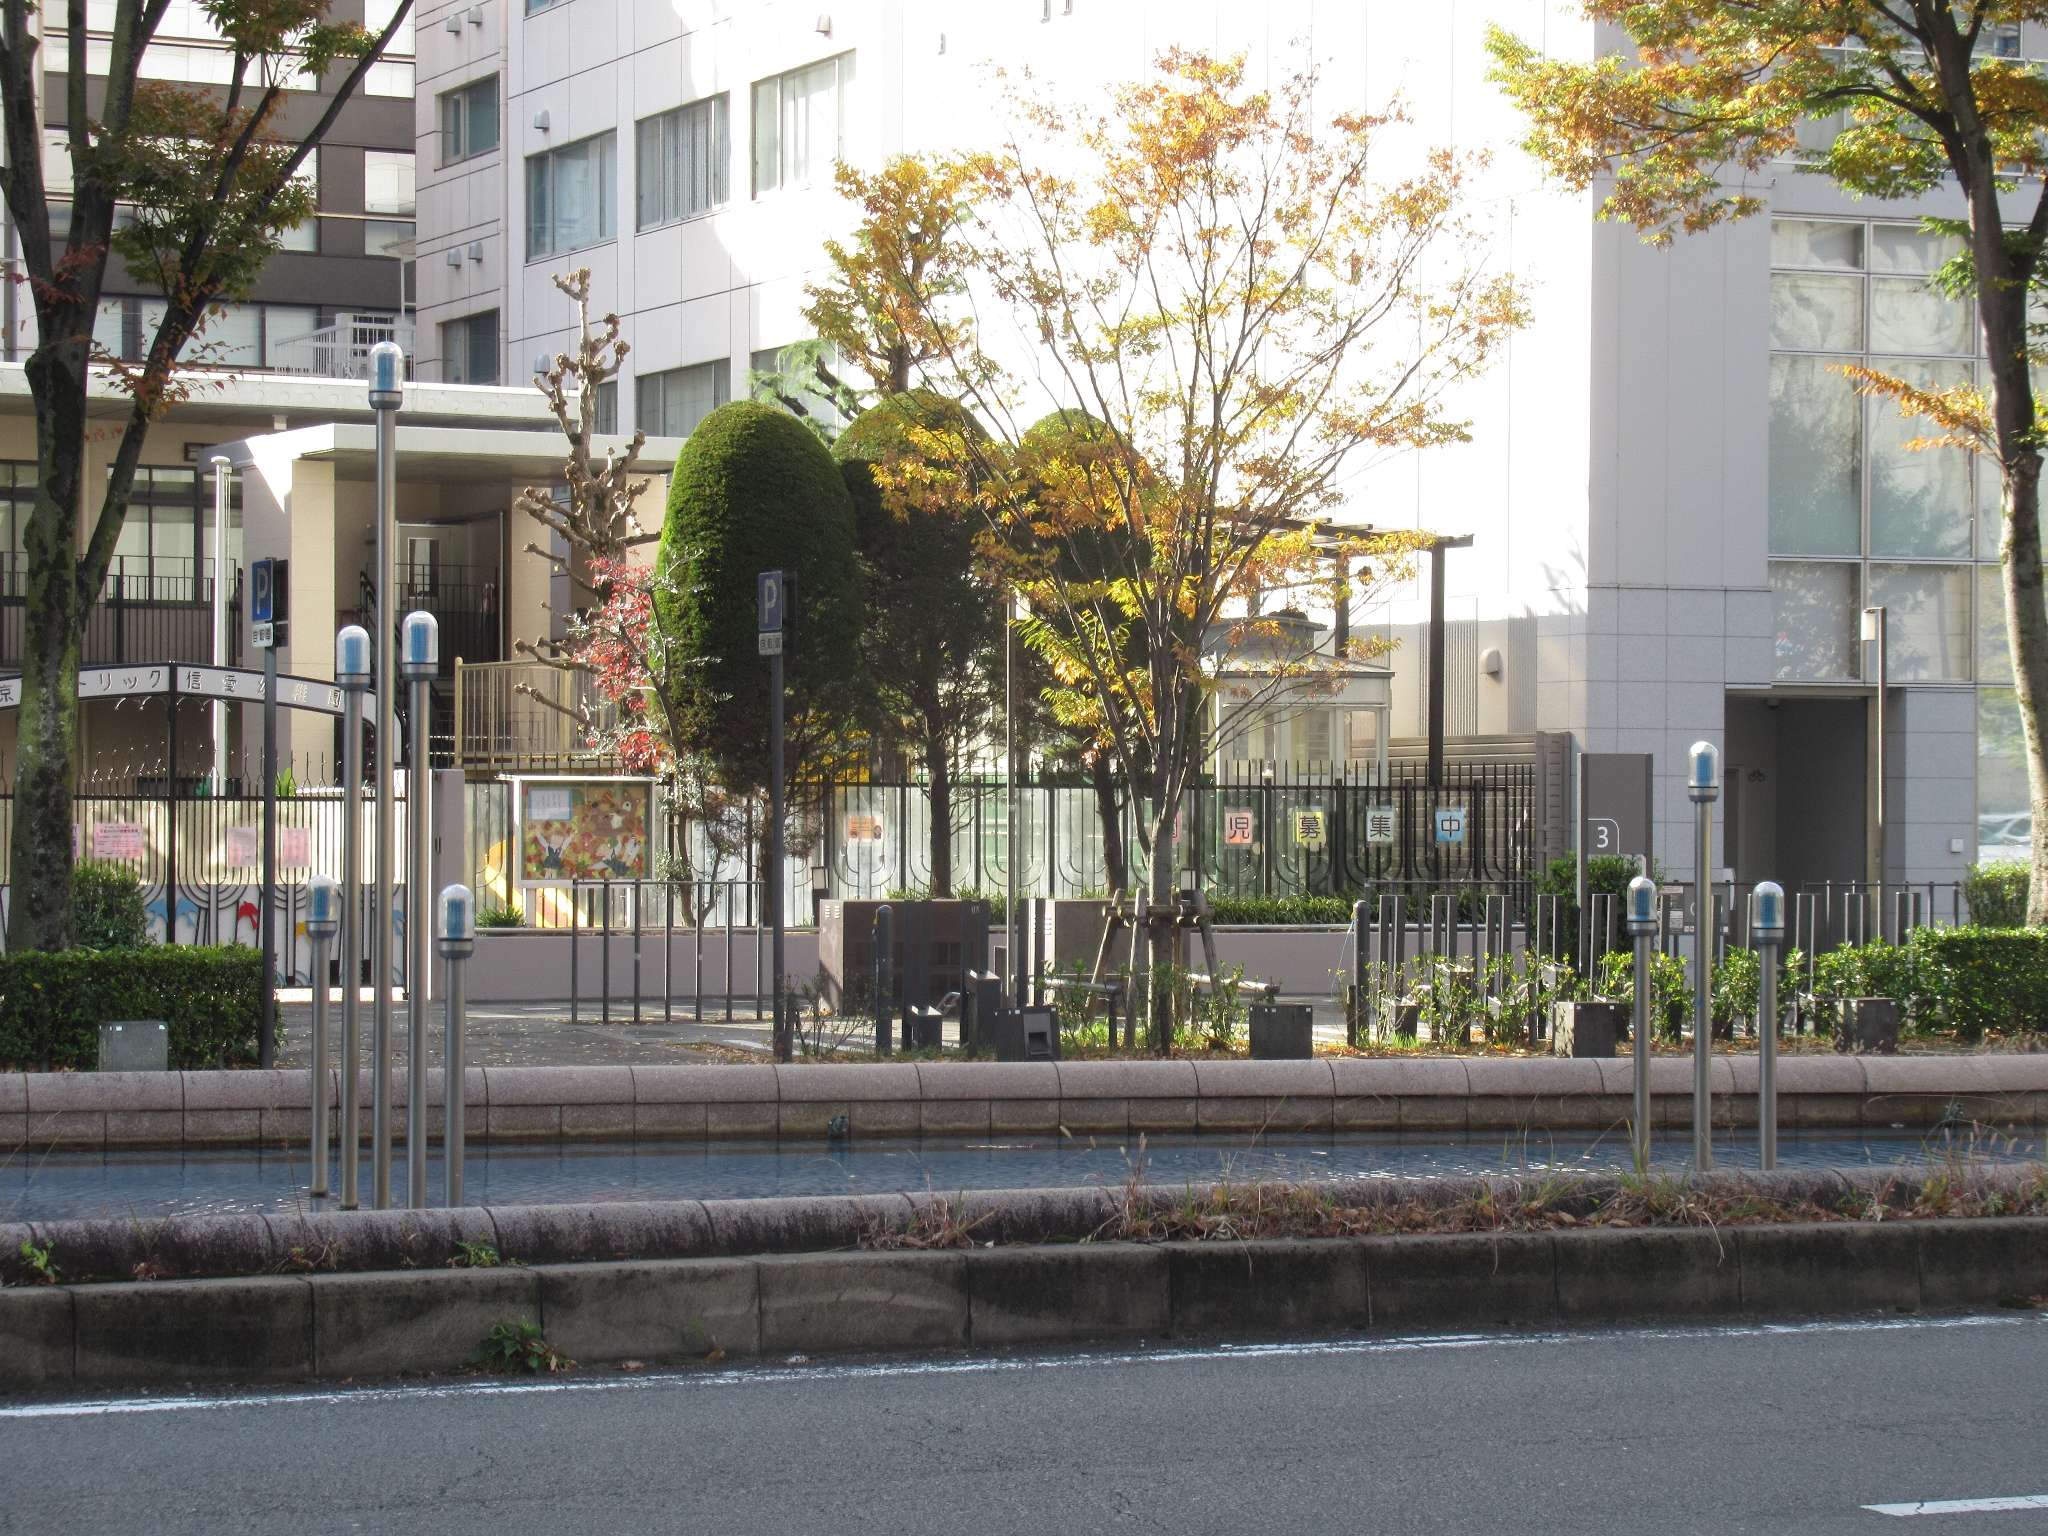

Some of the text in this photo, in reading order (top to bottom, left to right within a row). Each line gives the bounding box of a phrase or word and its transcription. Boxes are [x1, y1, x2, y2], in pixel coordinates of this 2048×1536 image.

[256, 568, 268, 615] P
[764, 579, 777, 624] P
[1596, 826, 1609, 848] 3
